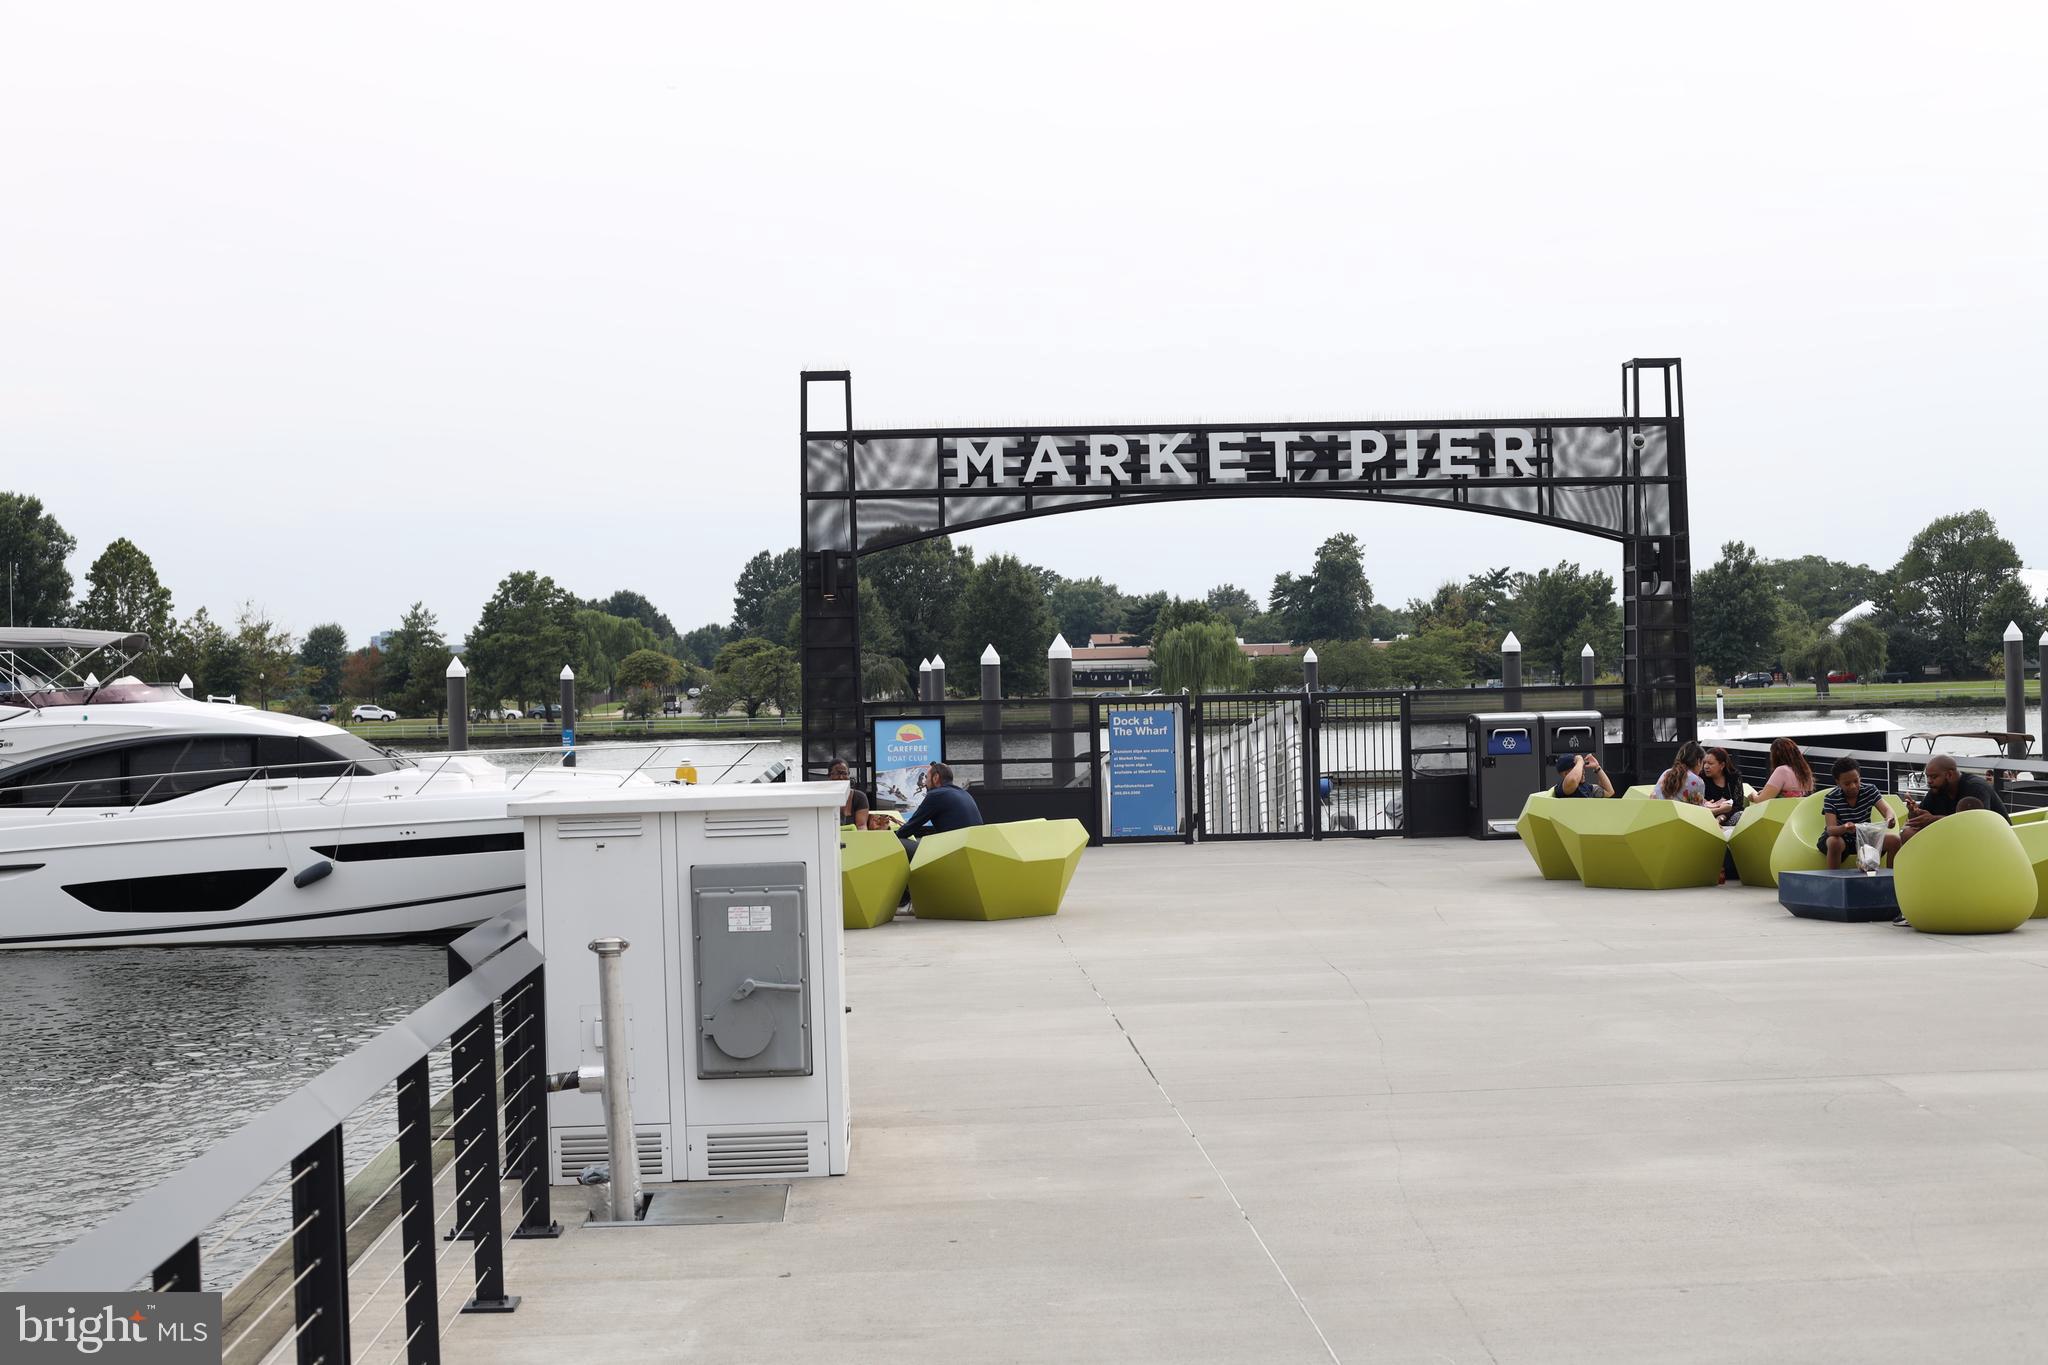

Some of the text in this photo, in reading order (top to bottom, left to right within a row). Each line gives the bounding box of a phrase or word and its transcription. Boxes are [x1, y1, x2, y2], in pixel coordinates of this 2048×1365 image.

[956, 428, 1536, 484] MARKET PIER
[1113, 716, 1154, 726] Dock at
[1113, 726, 1168, 736] The Wharf
[887, 744, 929, 753] CAREFREE
